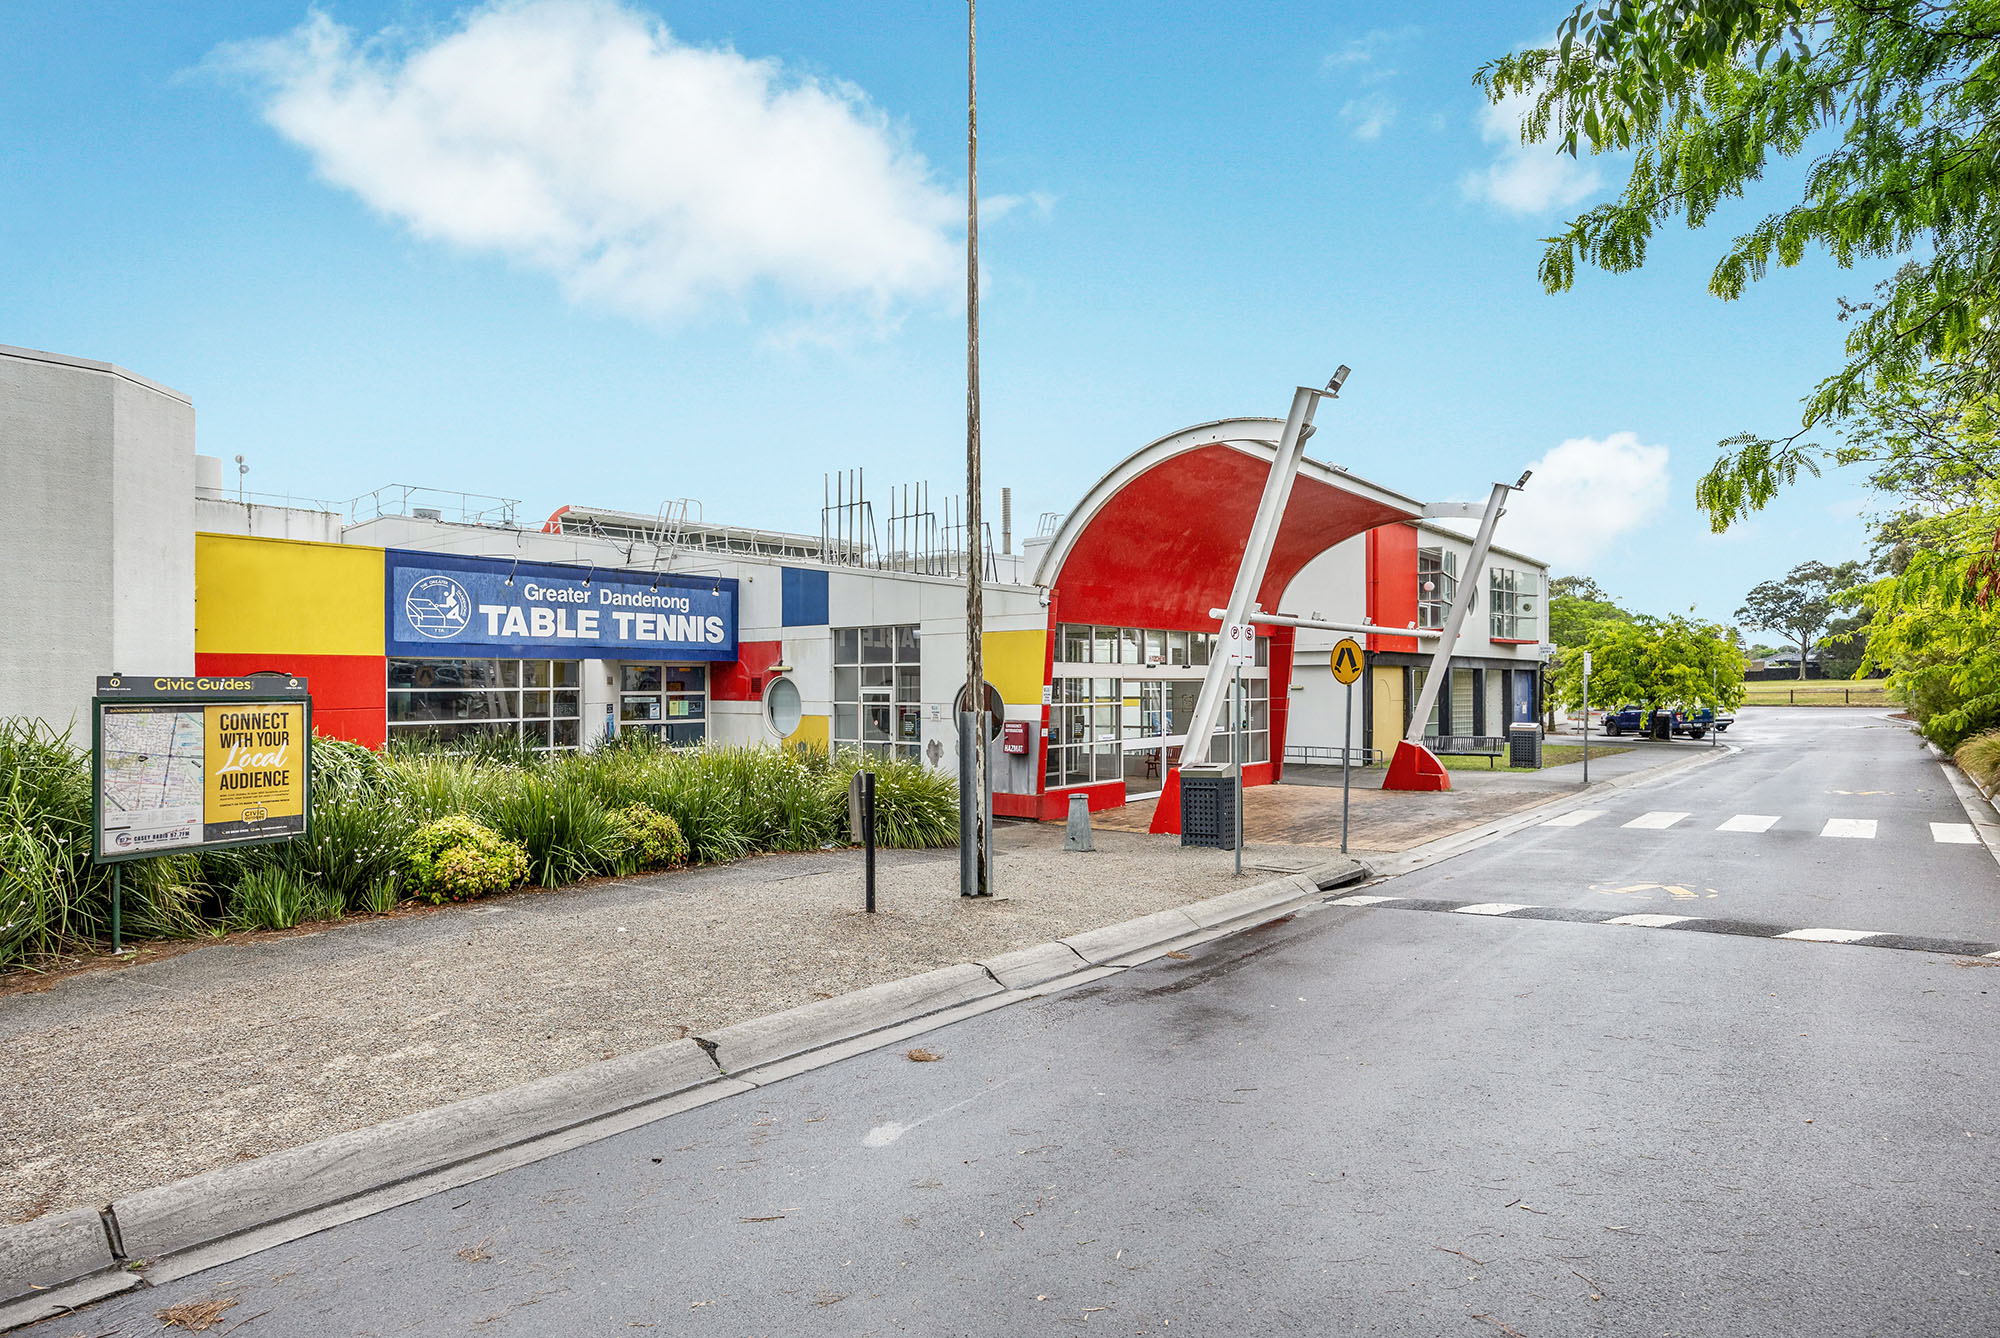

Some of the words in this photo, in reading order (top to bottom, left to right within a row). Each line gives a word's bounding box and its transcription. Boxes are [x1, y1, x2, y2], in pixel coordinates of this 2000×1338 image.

[524, 583, 592, 603] Greater
[600, 588, 690, 613] Dandenong
[479, 604, 600, 639] TABLE
[612, 611, 725, 644] TENNIS
[154, 678, 194, 691] Civic
[197, 678, 251, 691] Guides
[220, 712, 289, 731] CONNECT
[220, 732, 253, 749] WITH
[257, 731, 289, 747] YOUR
[1004, 744, 1024, 753] HAZMAT
[216, 739, 288, 776] Local
[220, 770, 289, 790] AUDIENCE
